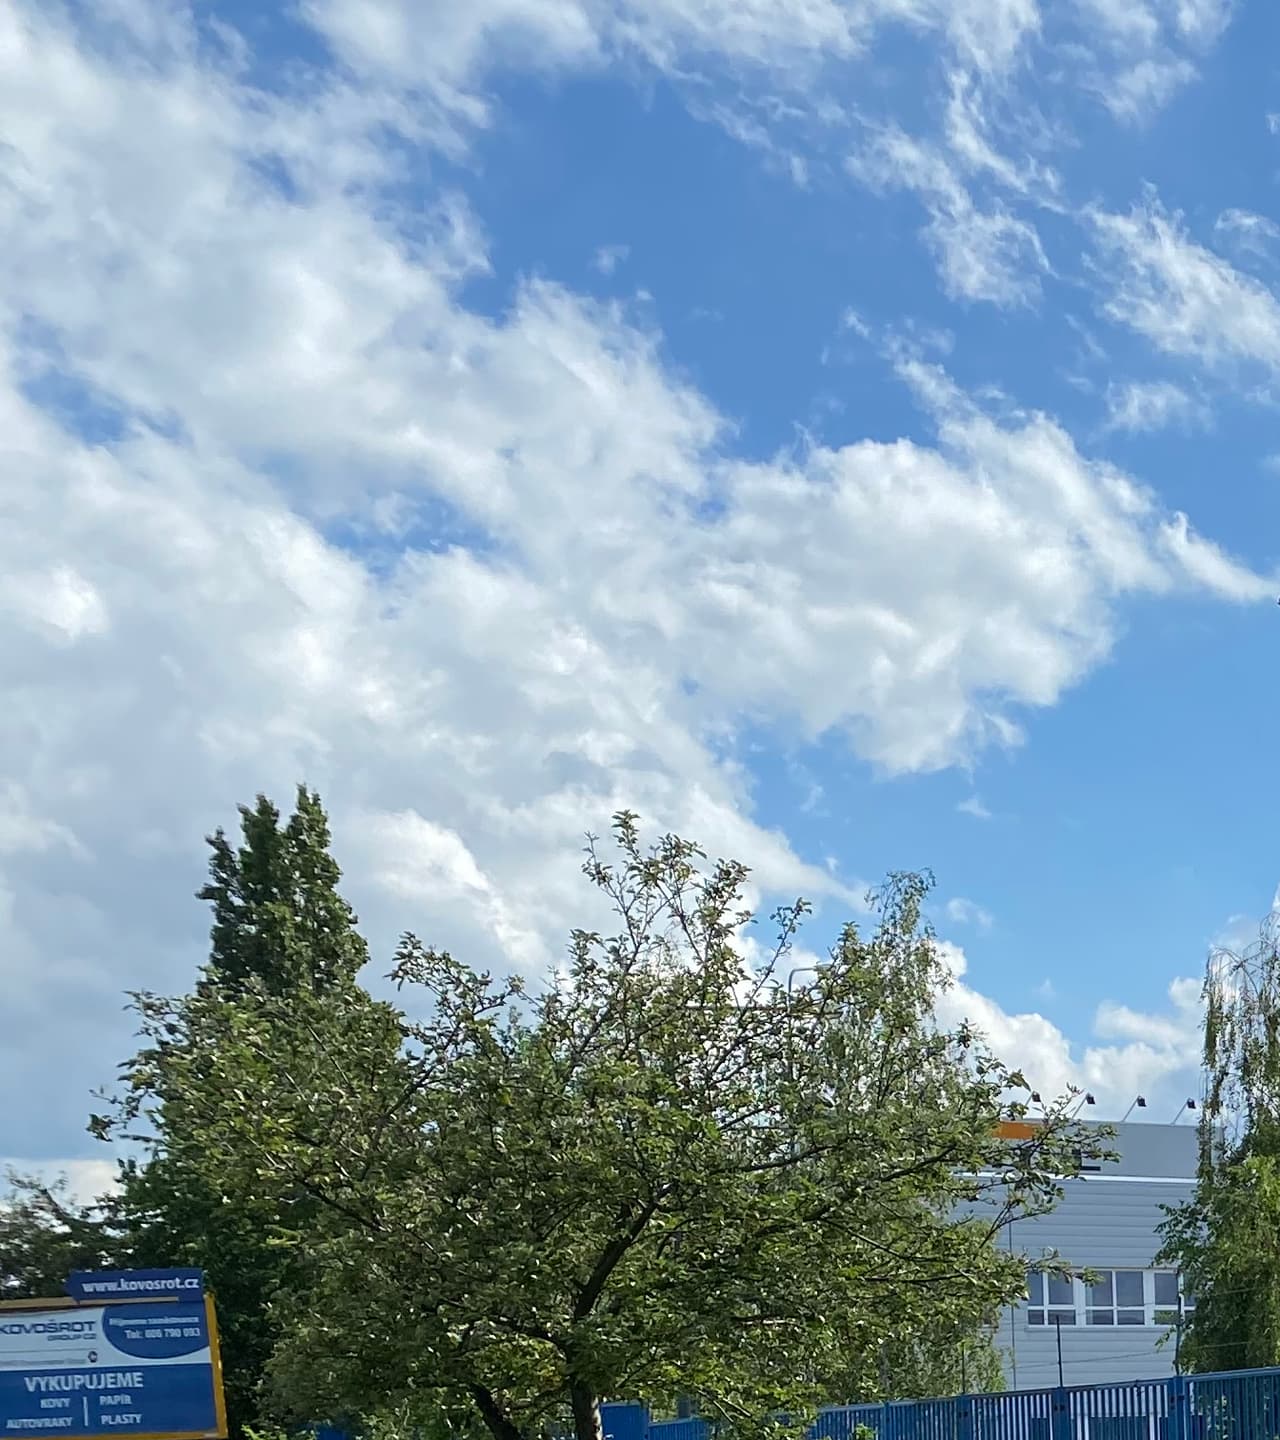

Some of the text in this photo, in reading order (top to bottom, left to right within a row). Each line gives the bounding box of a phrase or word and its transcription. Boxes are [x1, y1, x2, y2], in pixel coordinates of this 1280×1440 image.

[81, 1277, 199, 1293] www.kovosrot.cz
[24, 1372, 144, 1392] VYKUPUJEME
[40, 1397, 71, 1409] KOVY
[99, 1393, 133, 1406] PAPÍR
[6, 1416, 73, 1429] AUTOVRAKY
[101, 1413, 142, 1425] PLASTY
